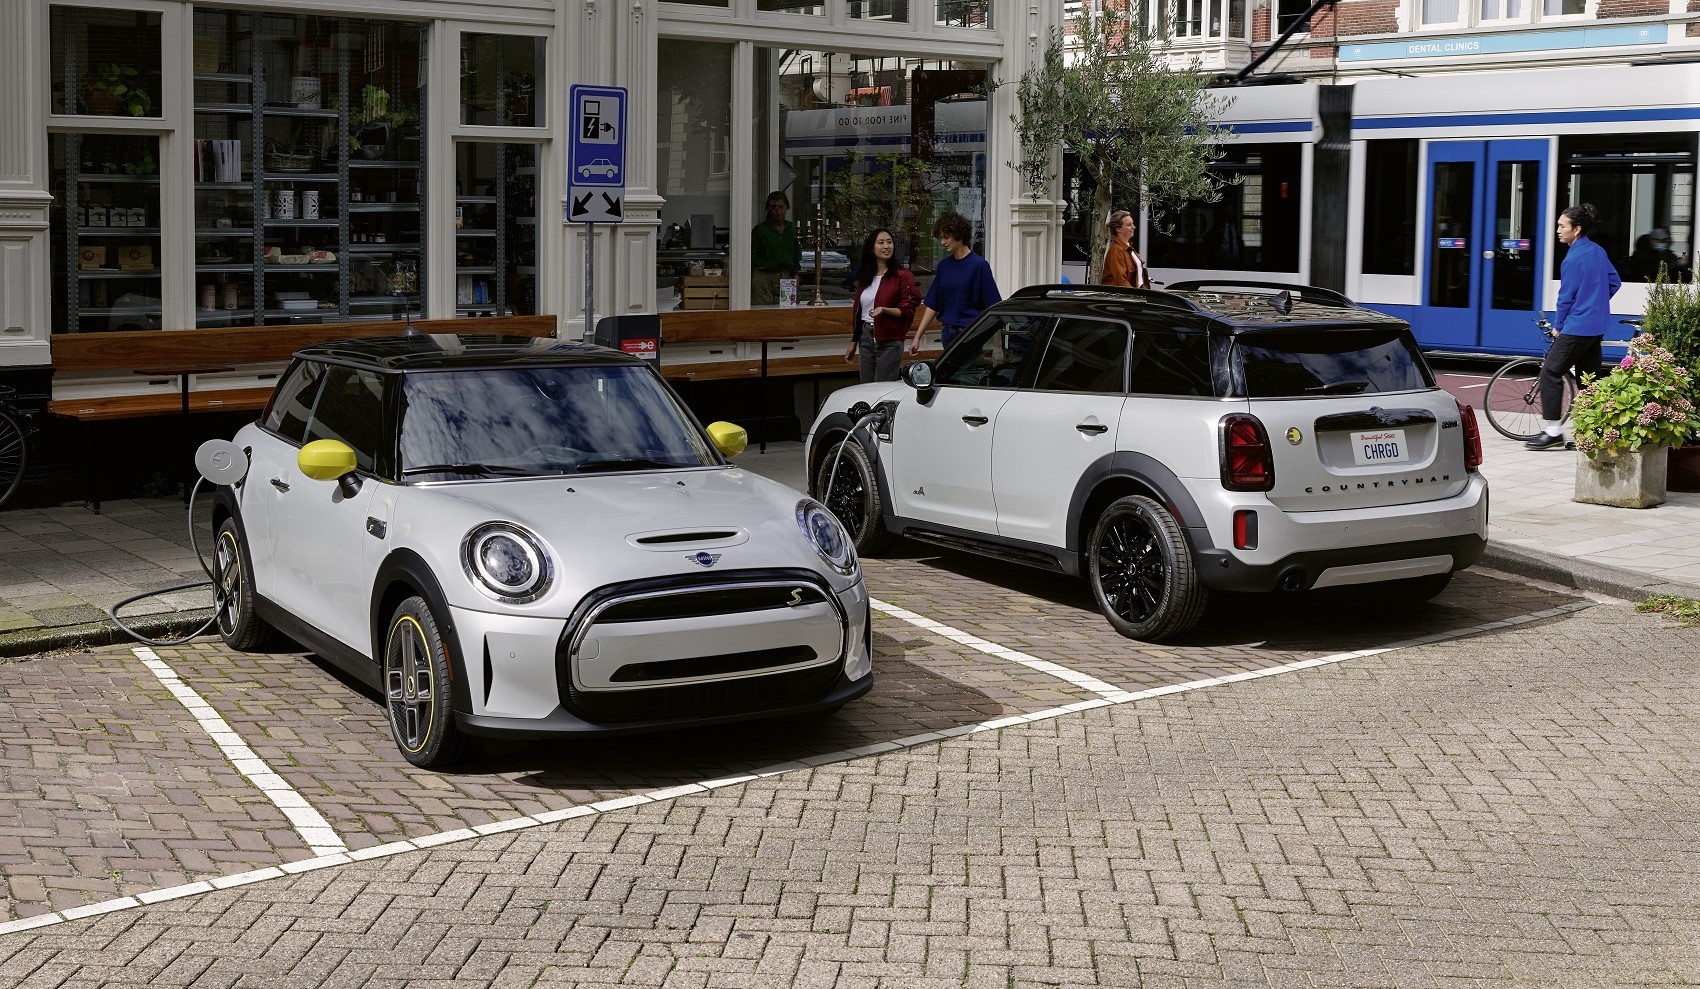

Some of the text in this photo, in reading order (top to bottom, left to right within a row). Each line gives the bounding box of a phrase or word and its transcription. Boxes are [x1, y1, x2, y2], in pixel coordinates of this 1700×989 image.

[1408, 41, 1479, 54] DENTAL CLINICS
[1364, 442, 1399, 460] CHRGD
[1305, 474, 1450, 494] COUNTRYMAN
[786, 588, 803, 606] S
